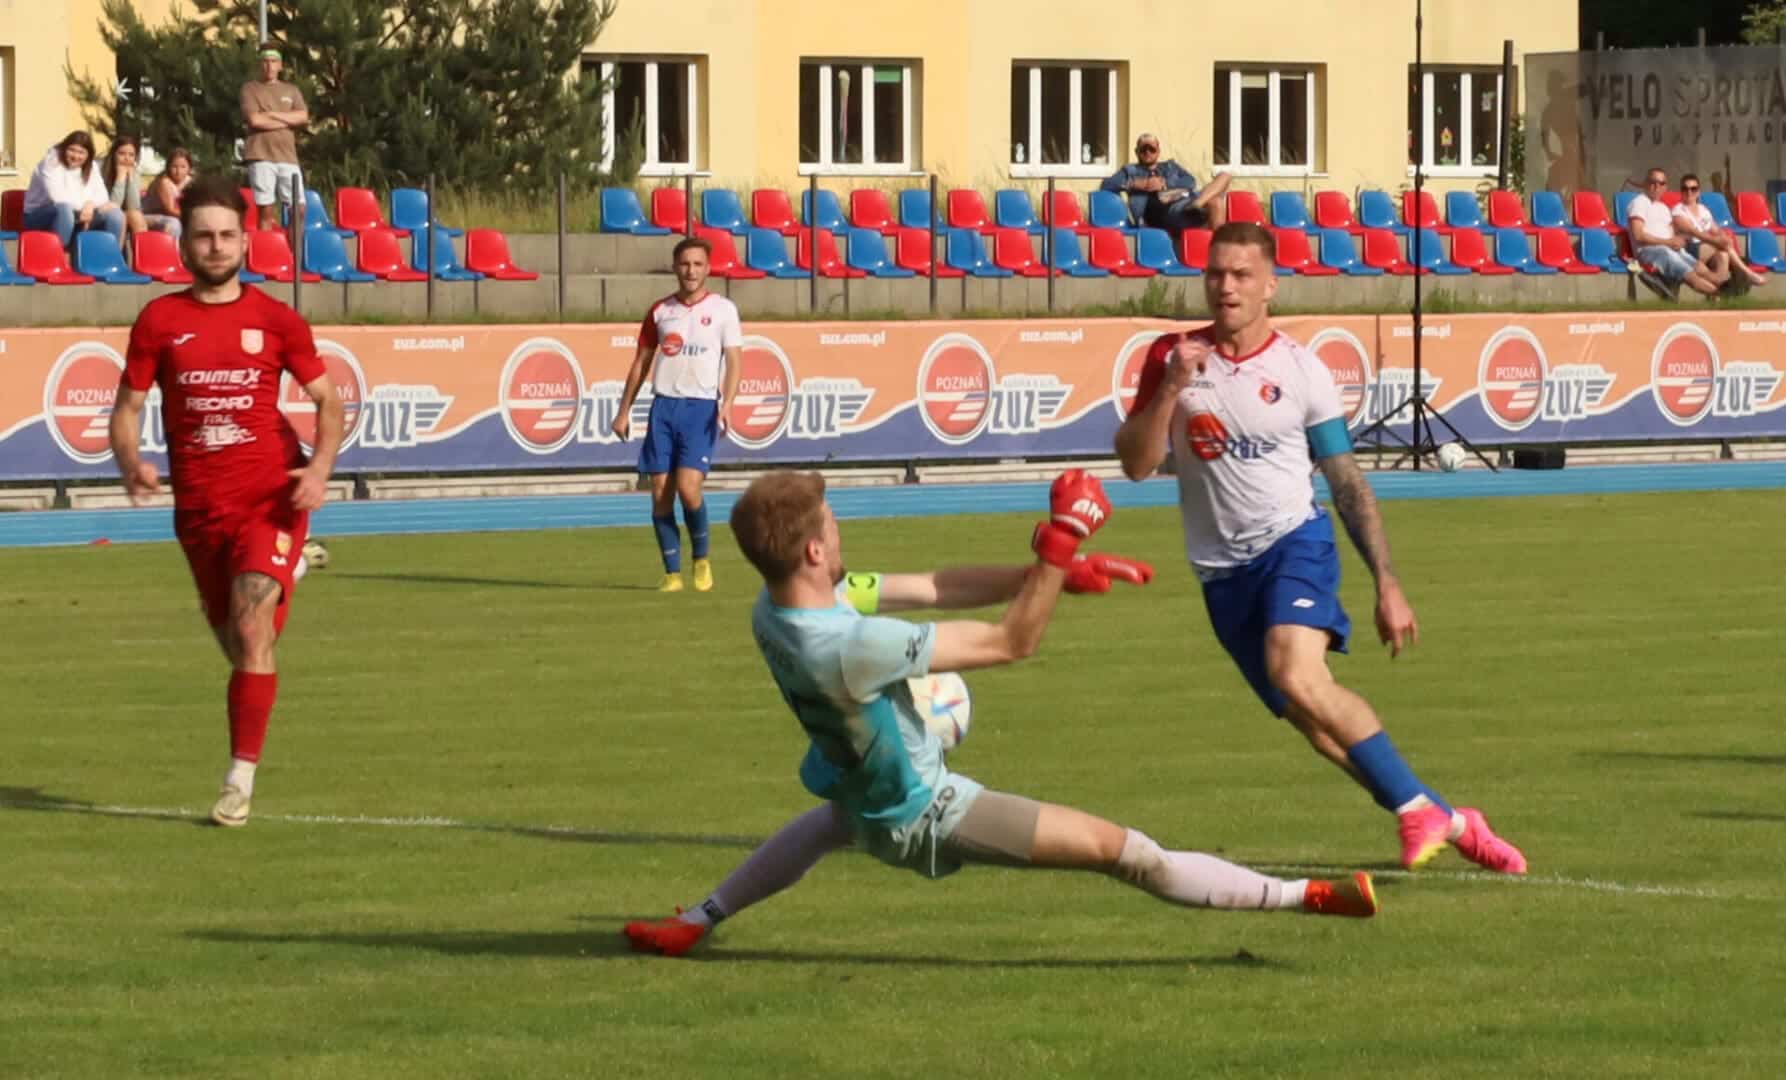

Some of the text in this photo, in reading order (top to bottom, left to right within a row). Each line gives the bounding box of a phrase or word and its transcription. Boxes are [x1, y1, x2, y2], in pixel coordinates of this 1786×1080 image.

[1585, 72, 1661, 119] VELO
[520, 378, 572, 397] POZNAŃ
[739, 375, 782, 393] OZNAŃ
[936, 371, 983, 390] POZNAŃ
[1544, 380, 1584, 415] ZUZ
[1715, 377, 1751, 412] ZUZ
[363, 401, 411, 442] ZUZ
[791, 394, 836, 433] ZUZ
[991, 390, 1035, 428] ZUZ
